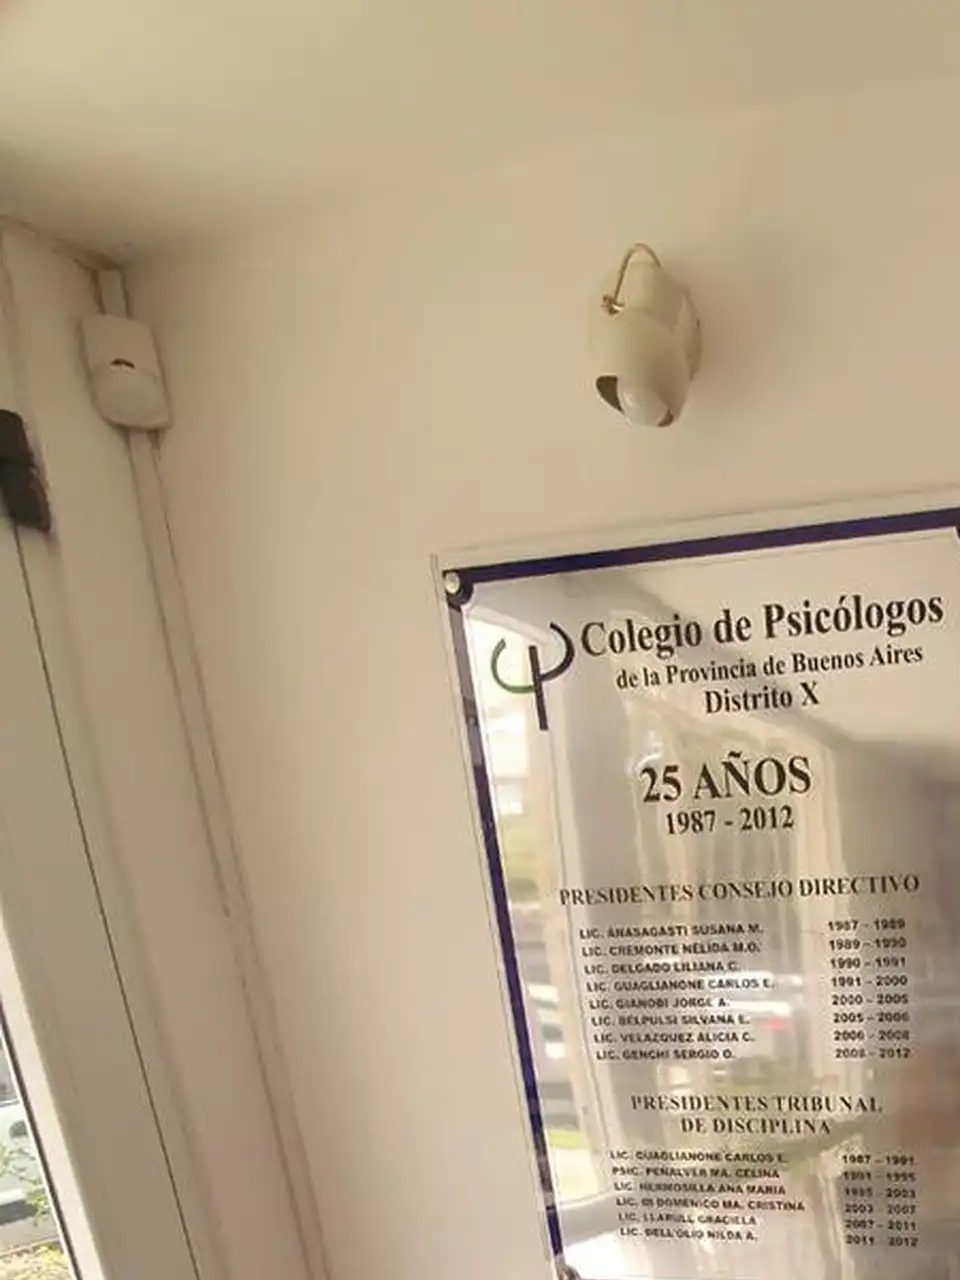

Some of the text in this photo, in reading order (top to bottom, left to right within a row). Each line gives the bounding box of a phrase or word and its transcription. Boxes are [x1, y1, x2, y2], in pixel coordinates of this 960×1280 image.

[581, 591, 944, 660] Colegio de Psicólogos
[616, 643, 924, 690] de la Provincia de Buenos Aires
[704, 681, 820, 715] Distrito X
[641, 750, 812, 803] 25 AÑOS
[665, 811, 716, 835] 1987
[739, 805, 795, 832] 2012
[560, 874, 920, 906] PRESIDENTES CONSEJO DIRECTIVO
[580, 929, 604, 939] LIC.
[692, 924, 745, 936] SUSANA
[582, 946, 607, 957] LIC.
[609, 944, 678, 956] CREMONTE
[584, 963, 609, 975] LIC.
[587, 981, 610, 993] LIC.
[614, 979, 705, 991] GUAGLIANONE
[708, 978, 759, 989] CARLOS
[590, 999, 612, 1010] LIC.
[592, 1015, 615, 1026] LIC.
[681, 1014, 734, 1025] SILVANA
[594, 1032, 617, 1043] LIC.
[697, 1031, 739, 1042] ALICIA
[597, 1049, 620, 1060] LIC.
[673, 1048, 719, 1059] SERGIO
[631, 1095, 882, 1113] PRESIDENTES TRIBUNAL
[681, 1116, 831, 1135] DE DISCIPLINA
[725, 1152, 774, 1163] CARLOS
[735, 1167, 780, 1178] CELINA
[718, 1184, 744, 1195] ANA
[747, 1201, 805, 1211] CRISTINA
